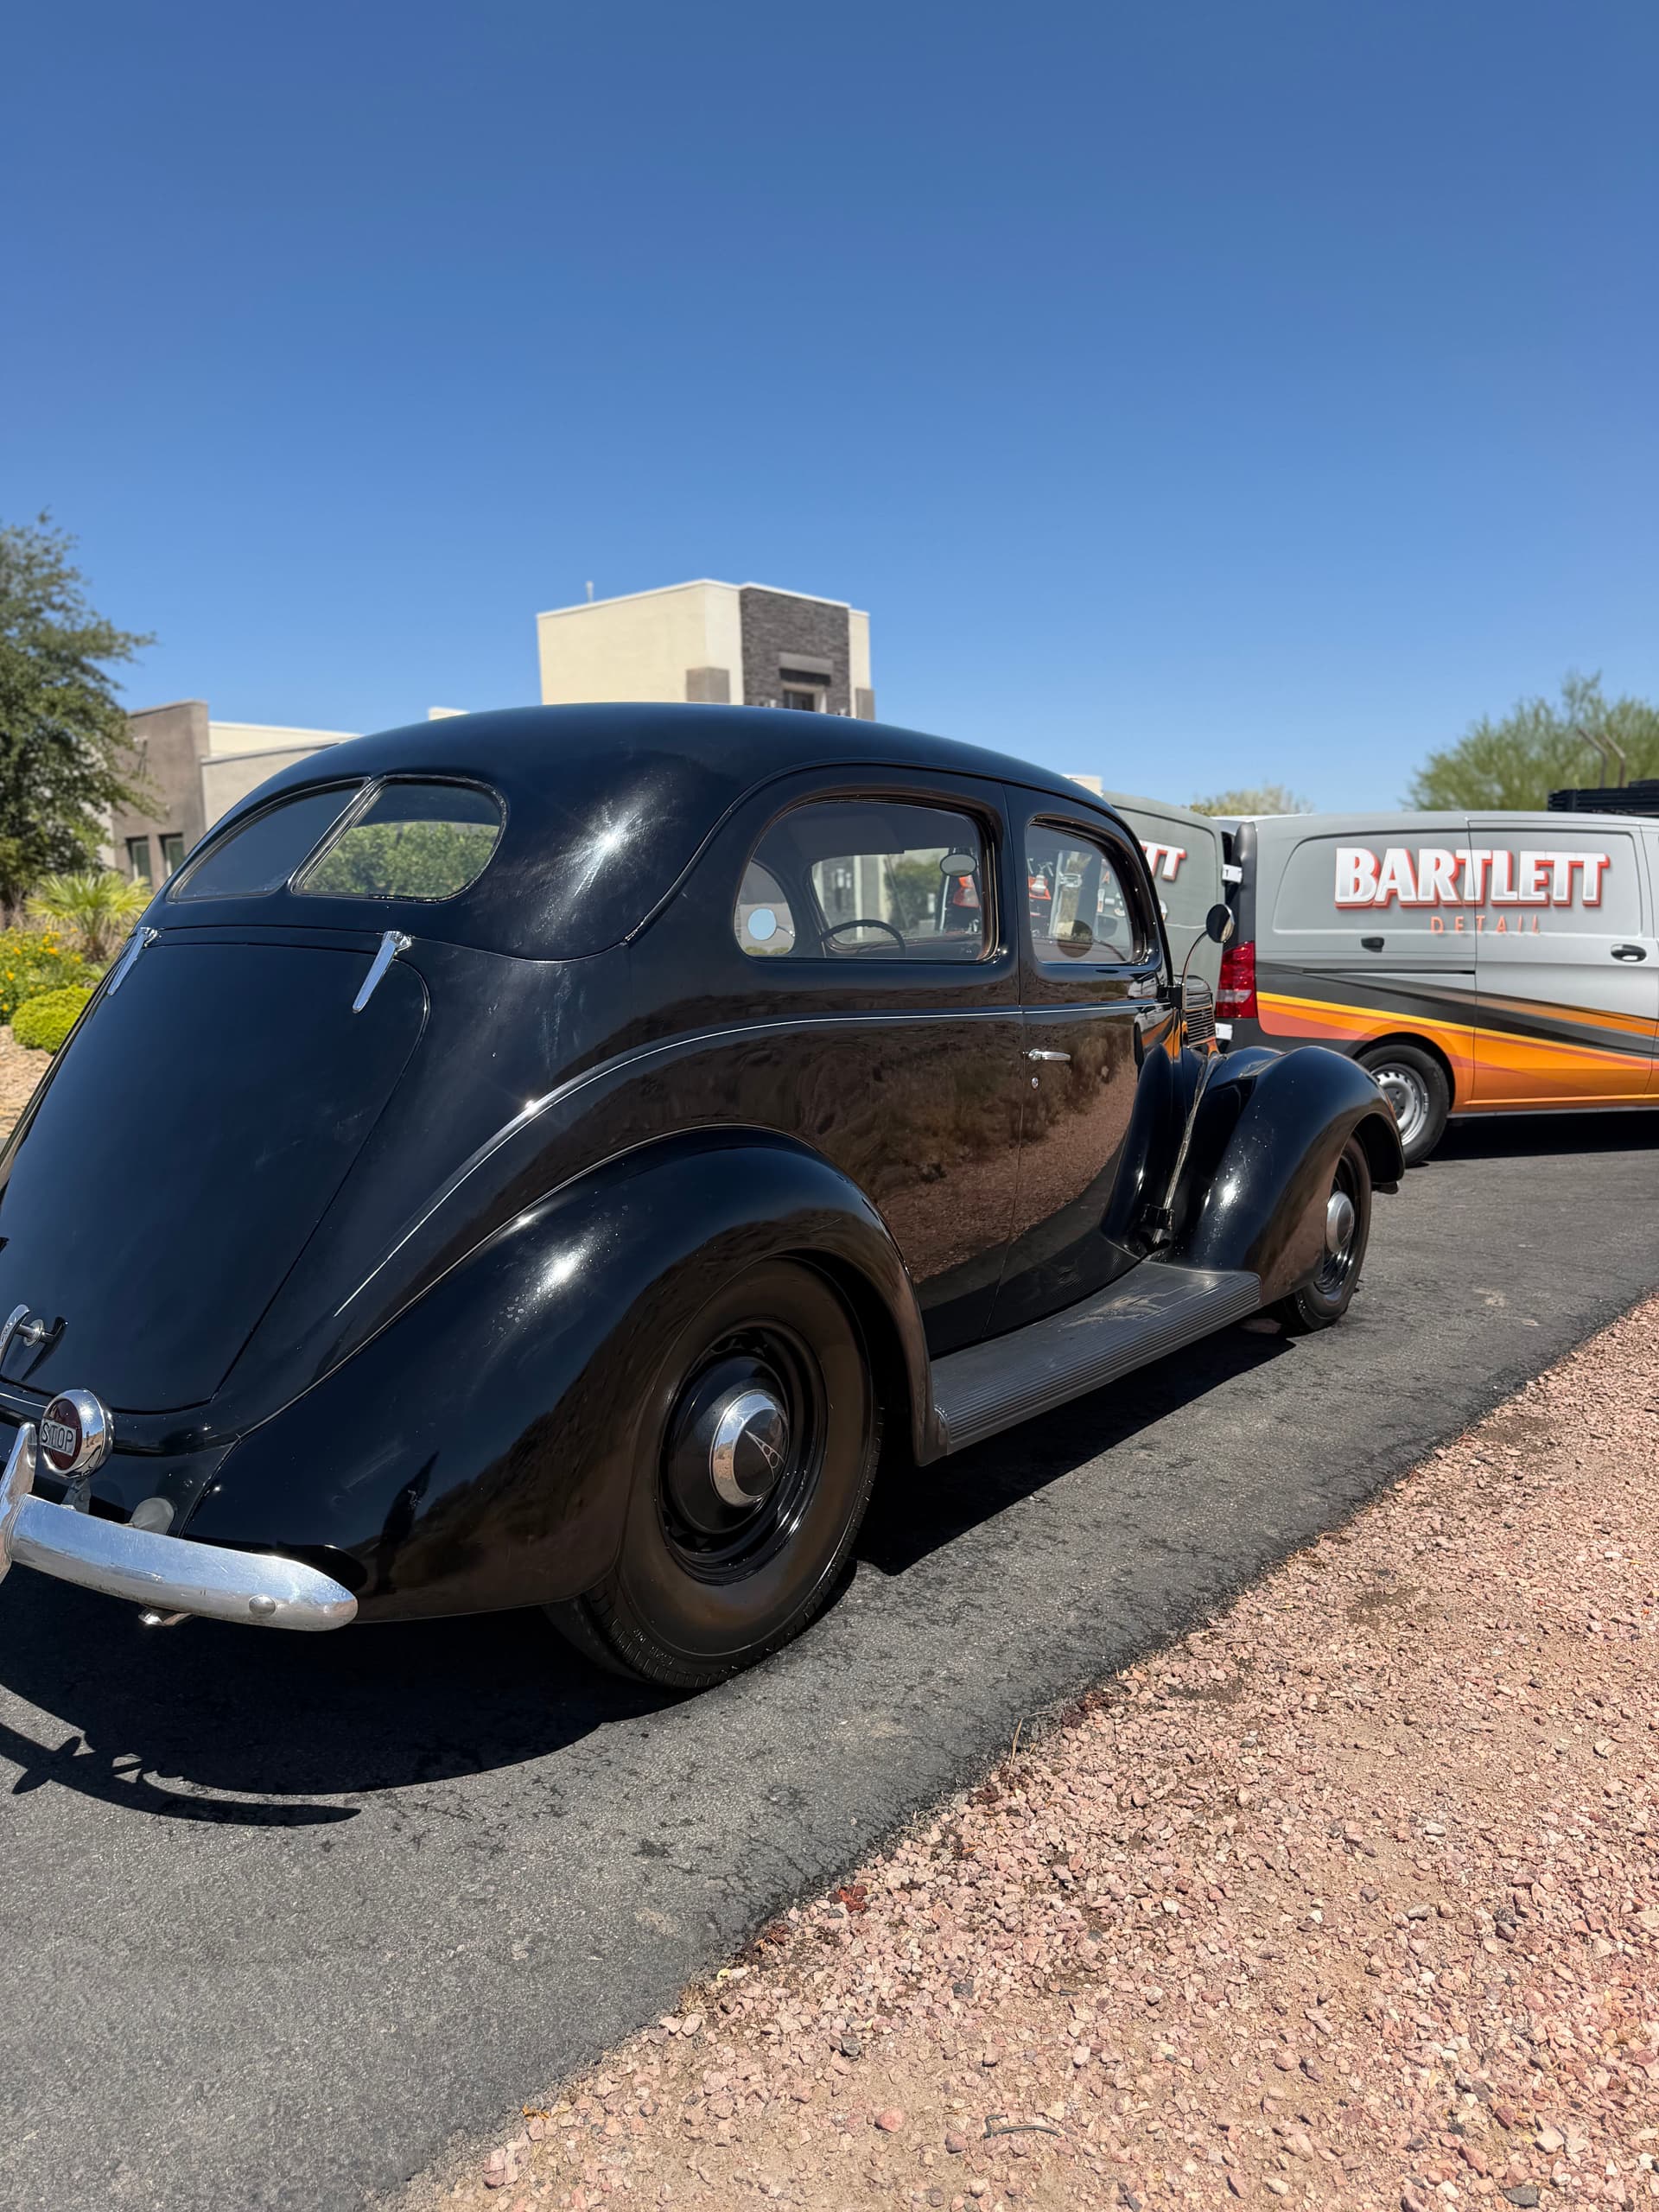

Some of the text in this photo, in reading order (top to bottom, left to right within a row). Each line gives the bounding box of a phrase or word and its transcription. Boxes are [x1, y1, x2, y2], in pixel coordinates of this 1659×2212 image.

[1334, 847, 1610, 908] BARTLETT
[1430, 914, 1541, 934] DETAIL
[42, 1421, 74, 1450] STOP
